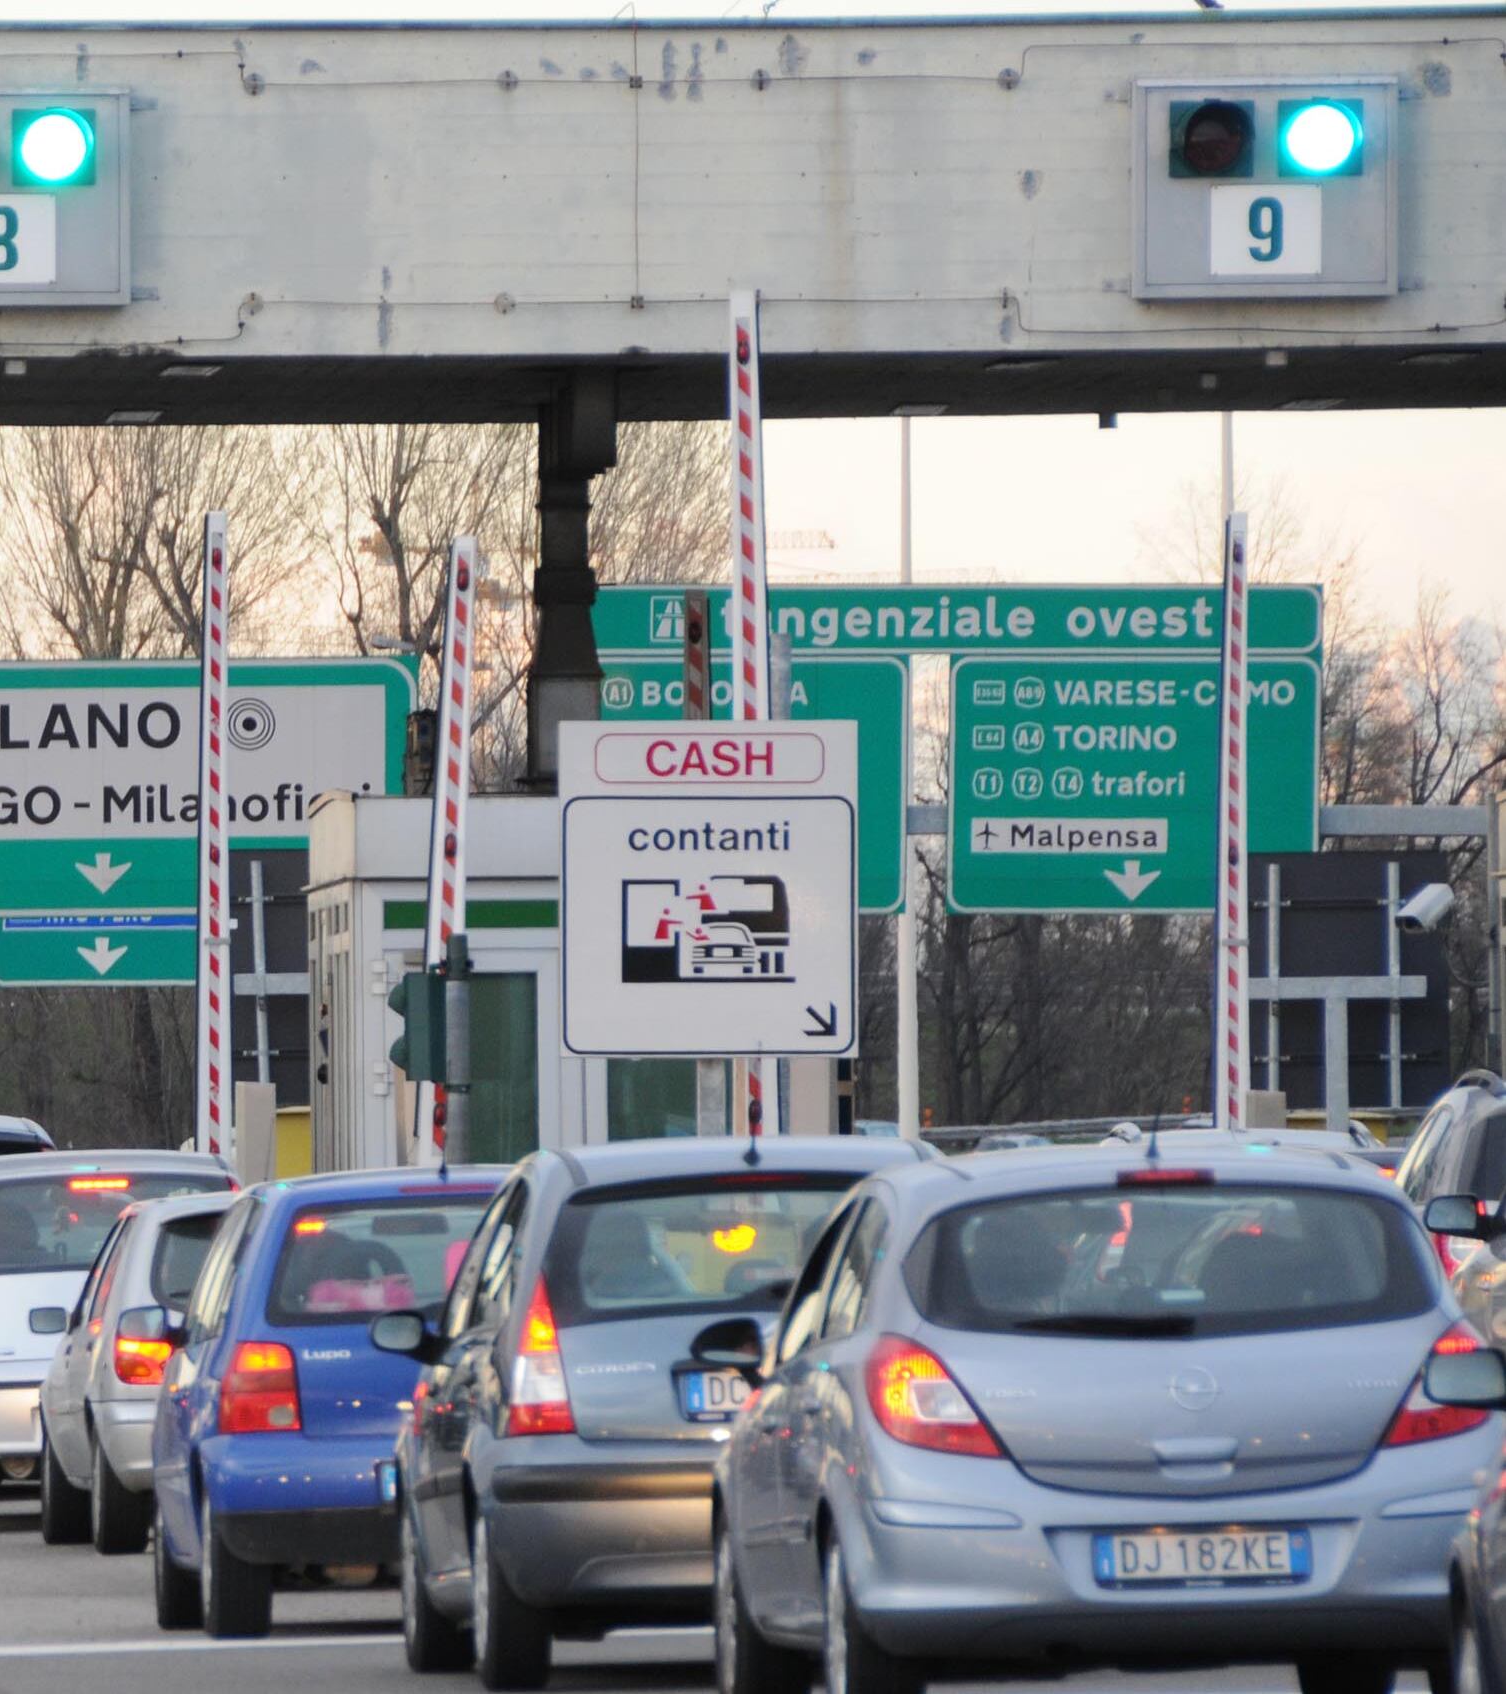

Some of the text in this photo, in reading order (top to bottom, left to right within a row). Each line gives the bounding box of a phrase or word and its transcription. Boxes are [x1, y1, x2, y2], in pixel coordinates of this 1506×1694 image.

[1247, 196, 1284, 262] 9
[720, 596, 1212, 646] tngenziale ovest
[608, 681, 808, 706] A1 BOOA
[1053, 680, 1295, 706] VARESE-CMO
[1017, 729, 1041, 747] A4
[1053, 725, 1178, 750] TORINO
[645, 739, 774, 777] CASH
[978, 771, 1186, 796] T1 T2 T4 trafori
[627, 820, 790, 851] contanti
[1010, 823, 1158, 851] Malpensa
[302, 1348, 351, 1362] Lupo
